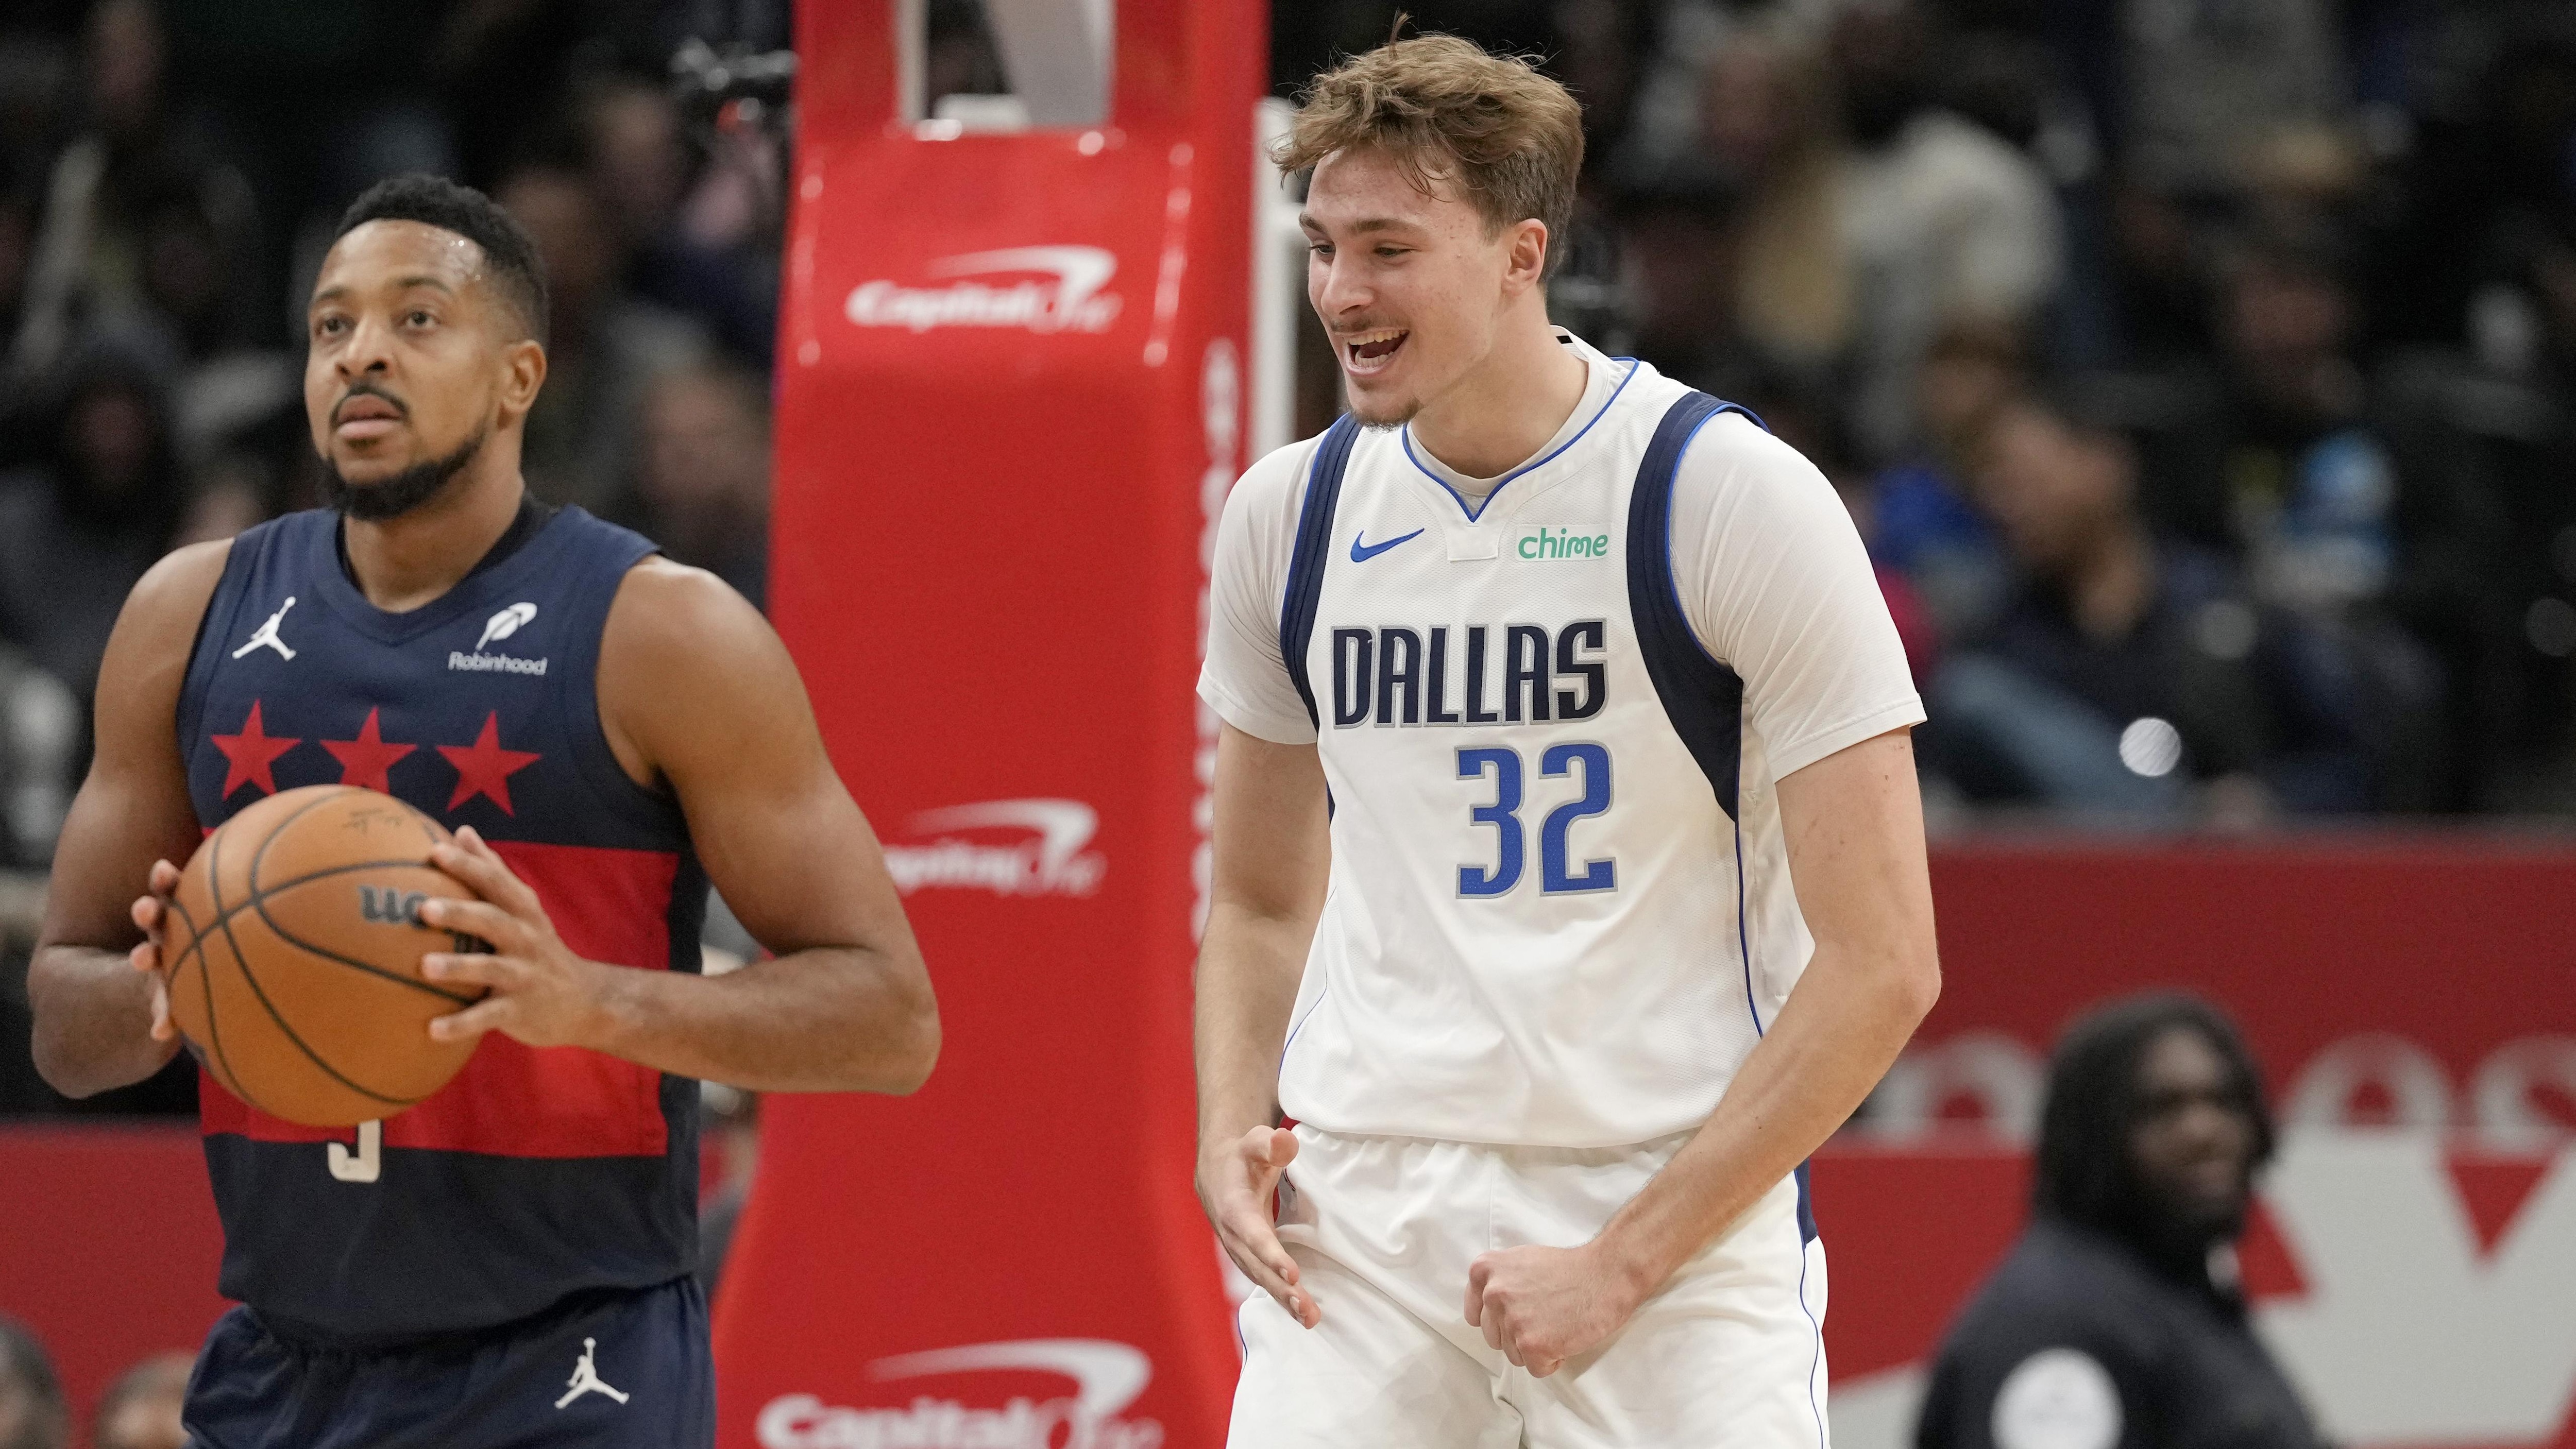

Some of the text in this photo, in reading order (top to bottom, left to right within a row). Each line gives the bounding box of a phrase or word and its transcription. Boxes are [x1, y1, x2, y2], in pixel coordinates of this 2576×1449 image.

[1518, 527, 1608, 559] chime
[448, 650, 548, 676] Robinhood
[1331, 619, 1608, 729] DALLAS
[1454, 739, 1618, 898] 32
